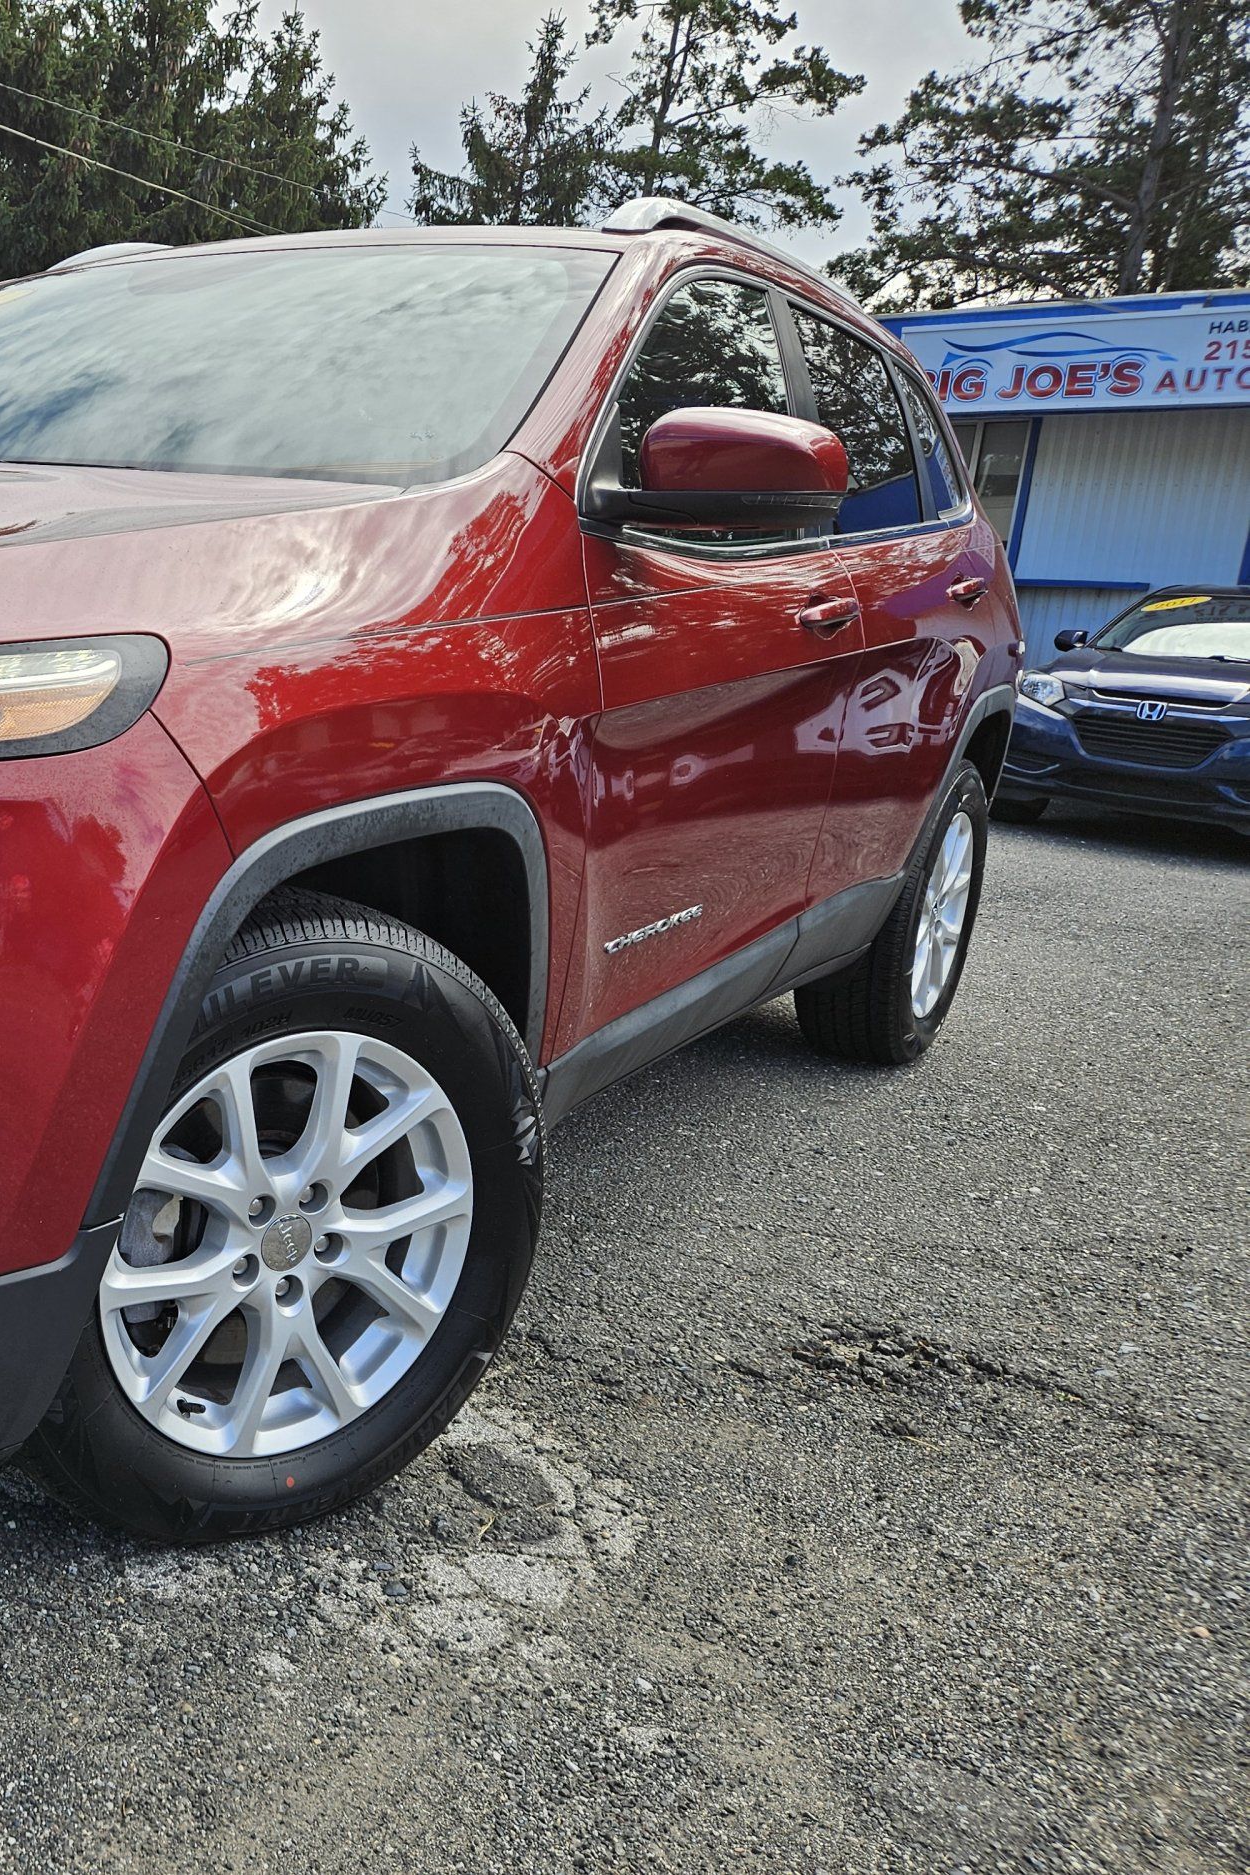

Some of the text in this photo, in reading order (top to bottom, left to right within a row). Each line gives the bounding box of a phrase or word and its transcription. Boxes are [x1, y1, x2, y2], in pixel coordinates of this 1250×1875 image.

[1208, 319, 1250, 334] HAB
[995, 359, 1147, 401] JOE'S
[603, 903, 703, 954] CHEROKEE
[278, 1223, 298, 1262] Jeep
